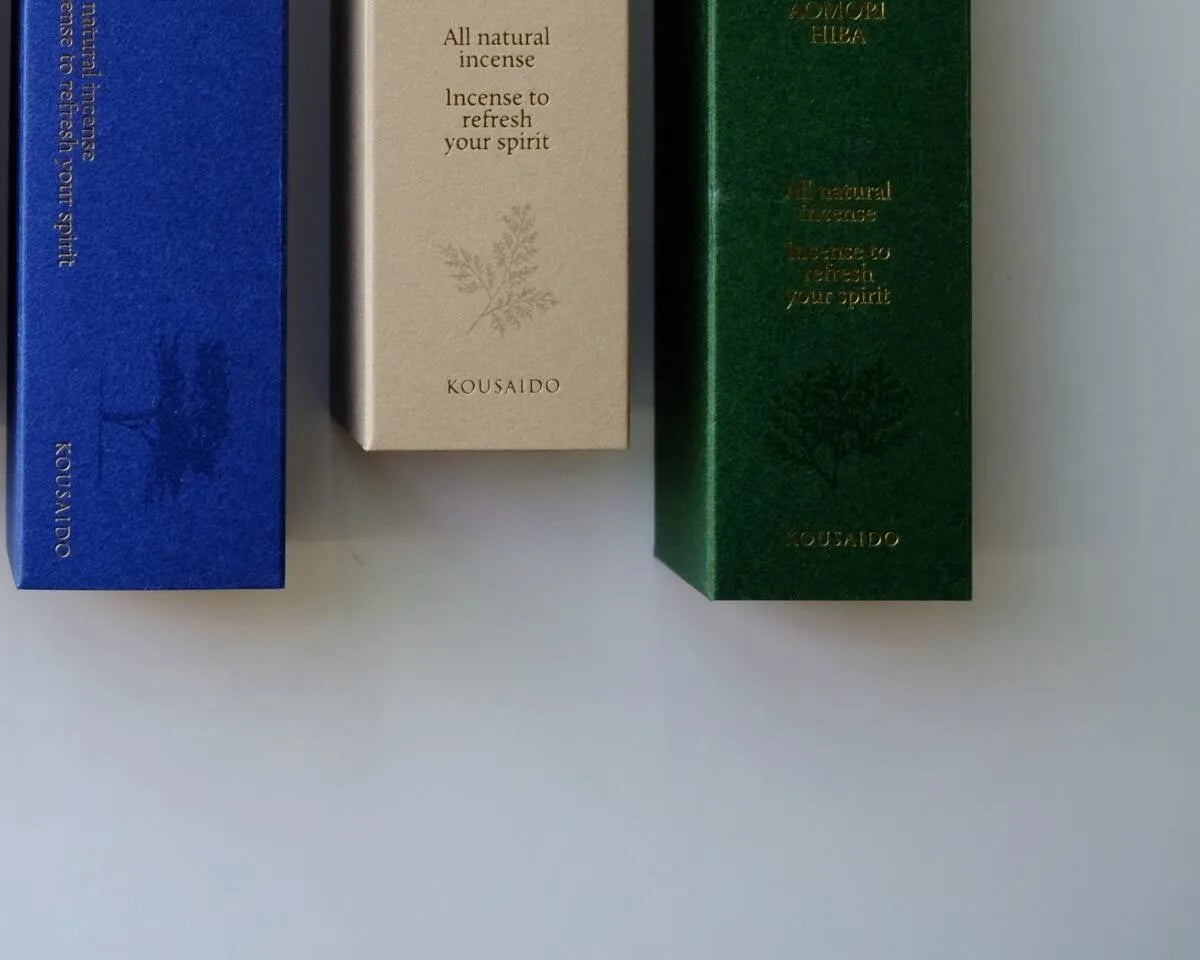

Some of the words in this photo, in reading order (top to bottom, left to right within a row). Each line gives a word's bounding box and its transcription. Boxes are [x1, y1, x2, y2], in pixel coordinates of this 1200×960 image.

[786, 1, 887, 20] AOMORI
[81, 2, 103, 78] natural
[443, 27, 471, 46] All
[478, 27, 551, 46] natural
[810, 25, 867, 45] HIBA
[59, 54, 75, 75] to
[459, 50, 535, 68] incense
[446, 88, 523, 106] Incense
[529, 91, 550, 106] to
[59, 80, 79, 153] refresh
[81, 82, 101, 162] incense
[462, 109, 532, 128] refresh
[444, 137, 491, 156] your
[497, 132, 550, 155] spirit
[54, 157, 73, 207] your
[818, 180, 892, 200] natural
[800, 204, 877, 222] incense
[54, 212, 78, 268] spirit
[870, 245, 891, 260] to
[805, 263, 875, 282] refresh
[786, 290, 833, 310] your
[839, 286, 891, 310] spirit
[447, 378, 561, 395] KOUSAIDO
[53, 442, 72, 560] KOUSAIDO
[784, 530, 900, 548] KOUSAIDO
